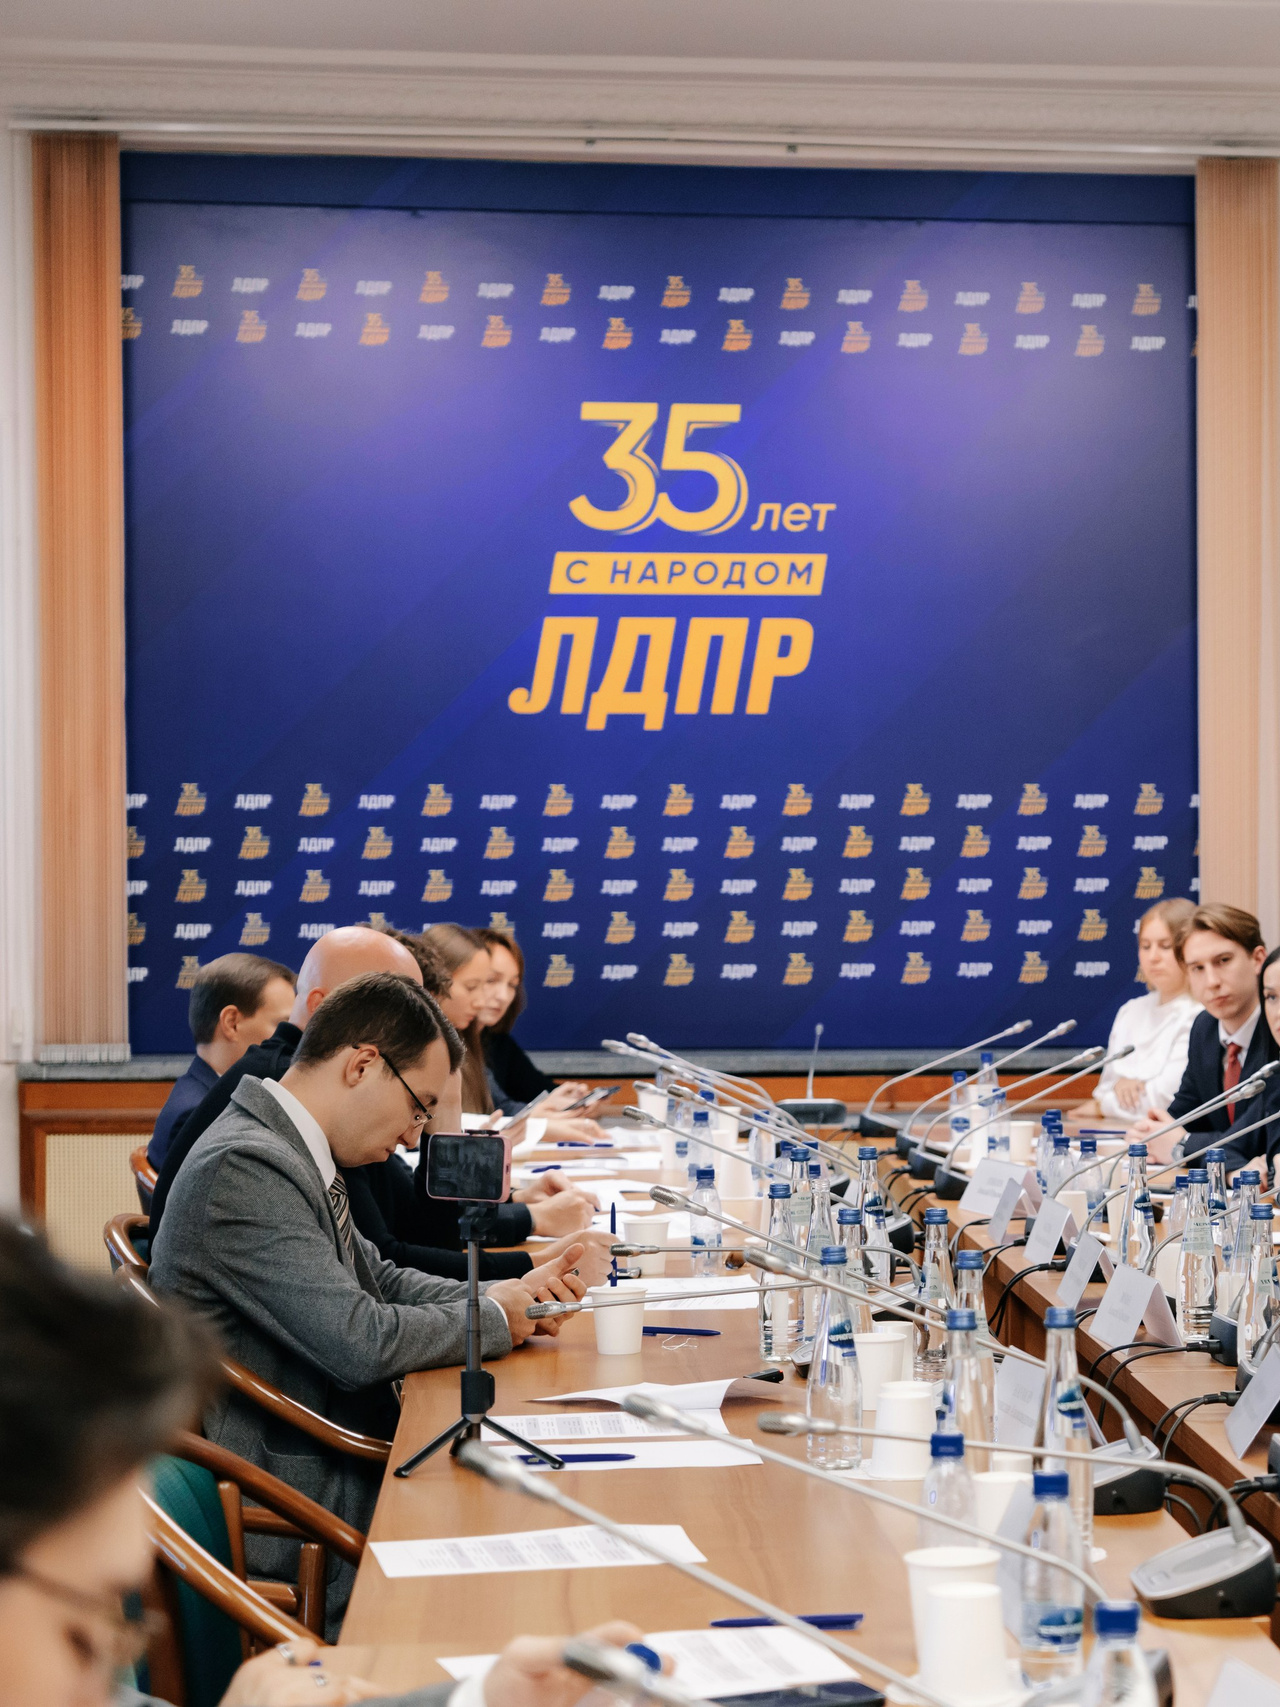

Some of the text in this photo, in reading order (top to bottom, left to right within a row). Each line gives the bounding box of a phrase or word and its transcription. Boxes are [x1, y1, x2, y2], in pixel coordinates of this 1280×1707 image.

[569, 401, 837, 535] 35 лет
[565, 560, 814, 589] С НАРОДОМ
[508, 616, 815, 731] ЛДПР
[234, 794, 273, 811] ЛДПР
[358, 795, 395, 810] ЛДПР
[480, 795, 517, 811] ЛДПР
[174, 837, 212, 854] ЛДПР
[297, 837, 335, 854] ЛДПР
[420, 837, 458, 854] ЛДПР
[235, 880, 273, 897] ЛДПР
[358, 880, 396, 897] ЛДПР
[480, 880, 517, 896] ЛДПР
[174, 923, 212, 940] ЛДПР
